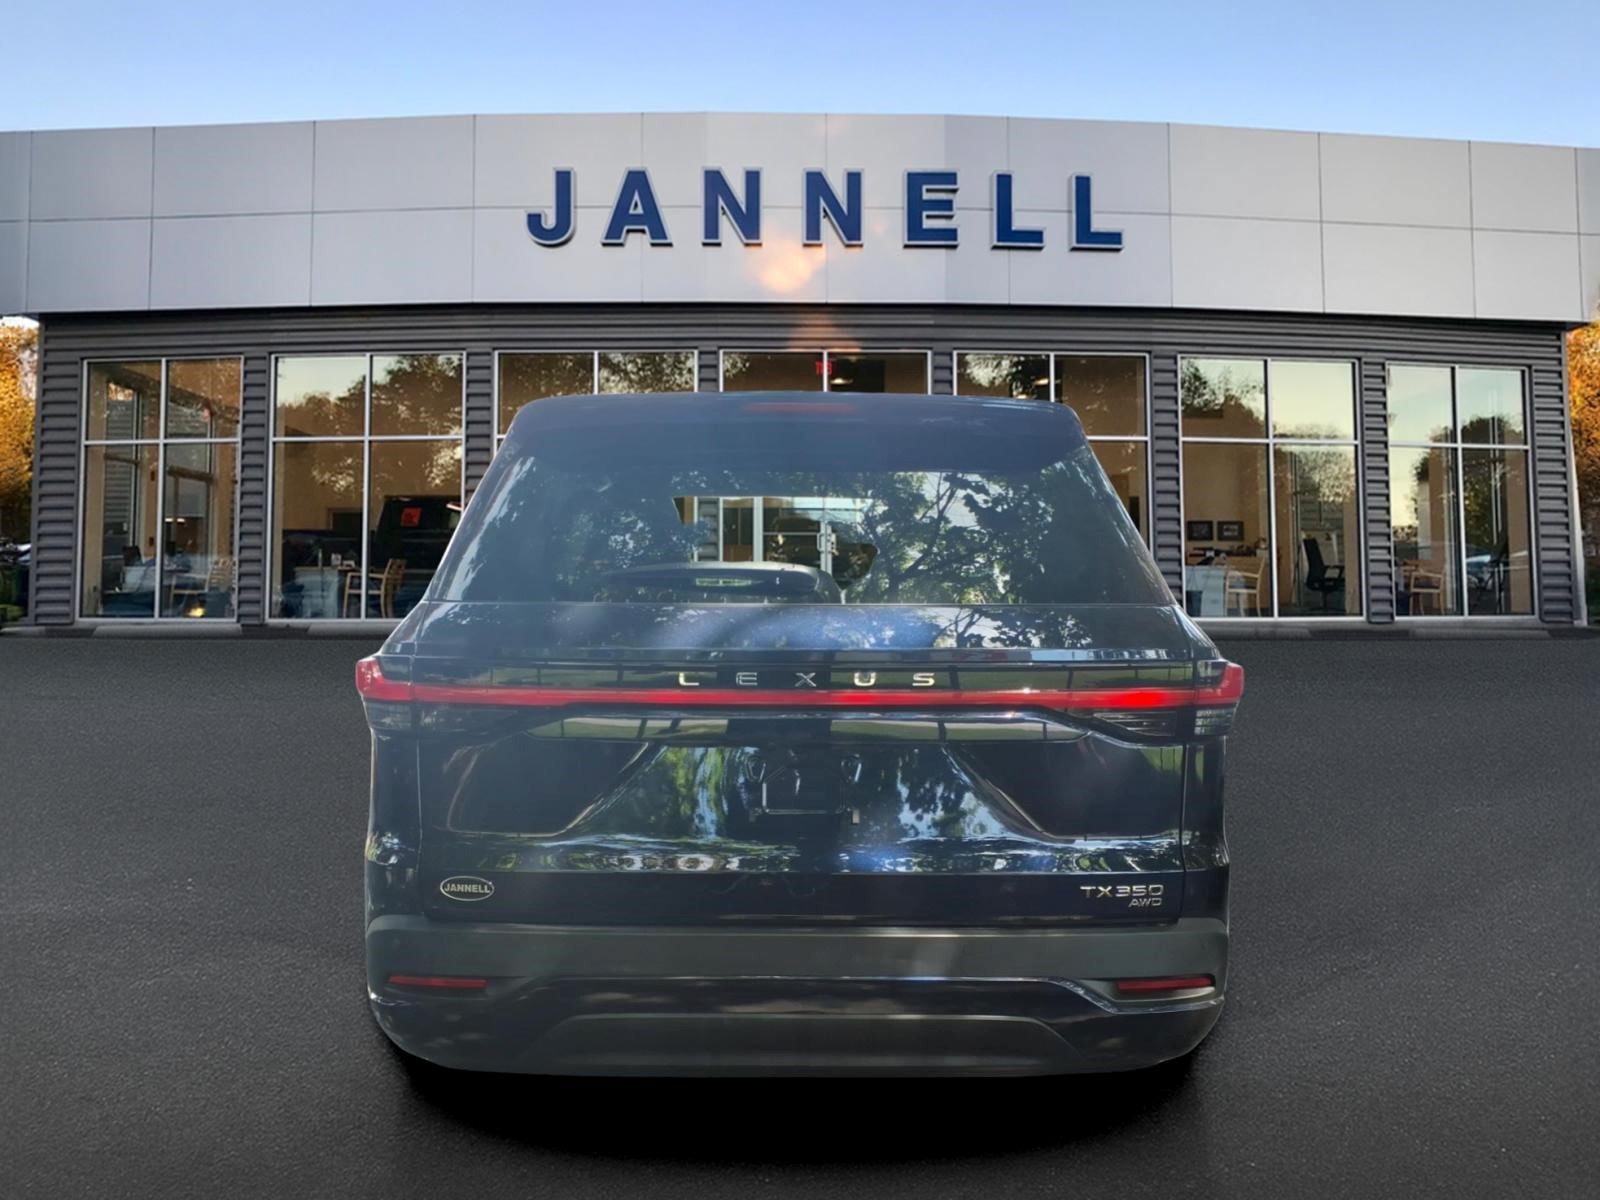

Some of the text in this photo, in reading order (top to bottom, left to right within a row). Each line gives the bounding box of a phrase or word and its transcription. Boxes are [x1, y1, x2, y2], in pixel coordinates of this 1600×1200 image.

[526, 166, 1125, 252] JANNELL
[678, 671, 936, 688] LEXUS
[444, 883, 491, 894] JANNELL
[1128, 897, 1163, 908] AWD
